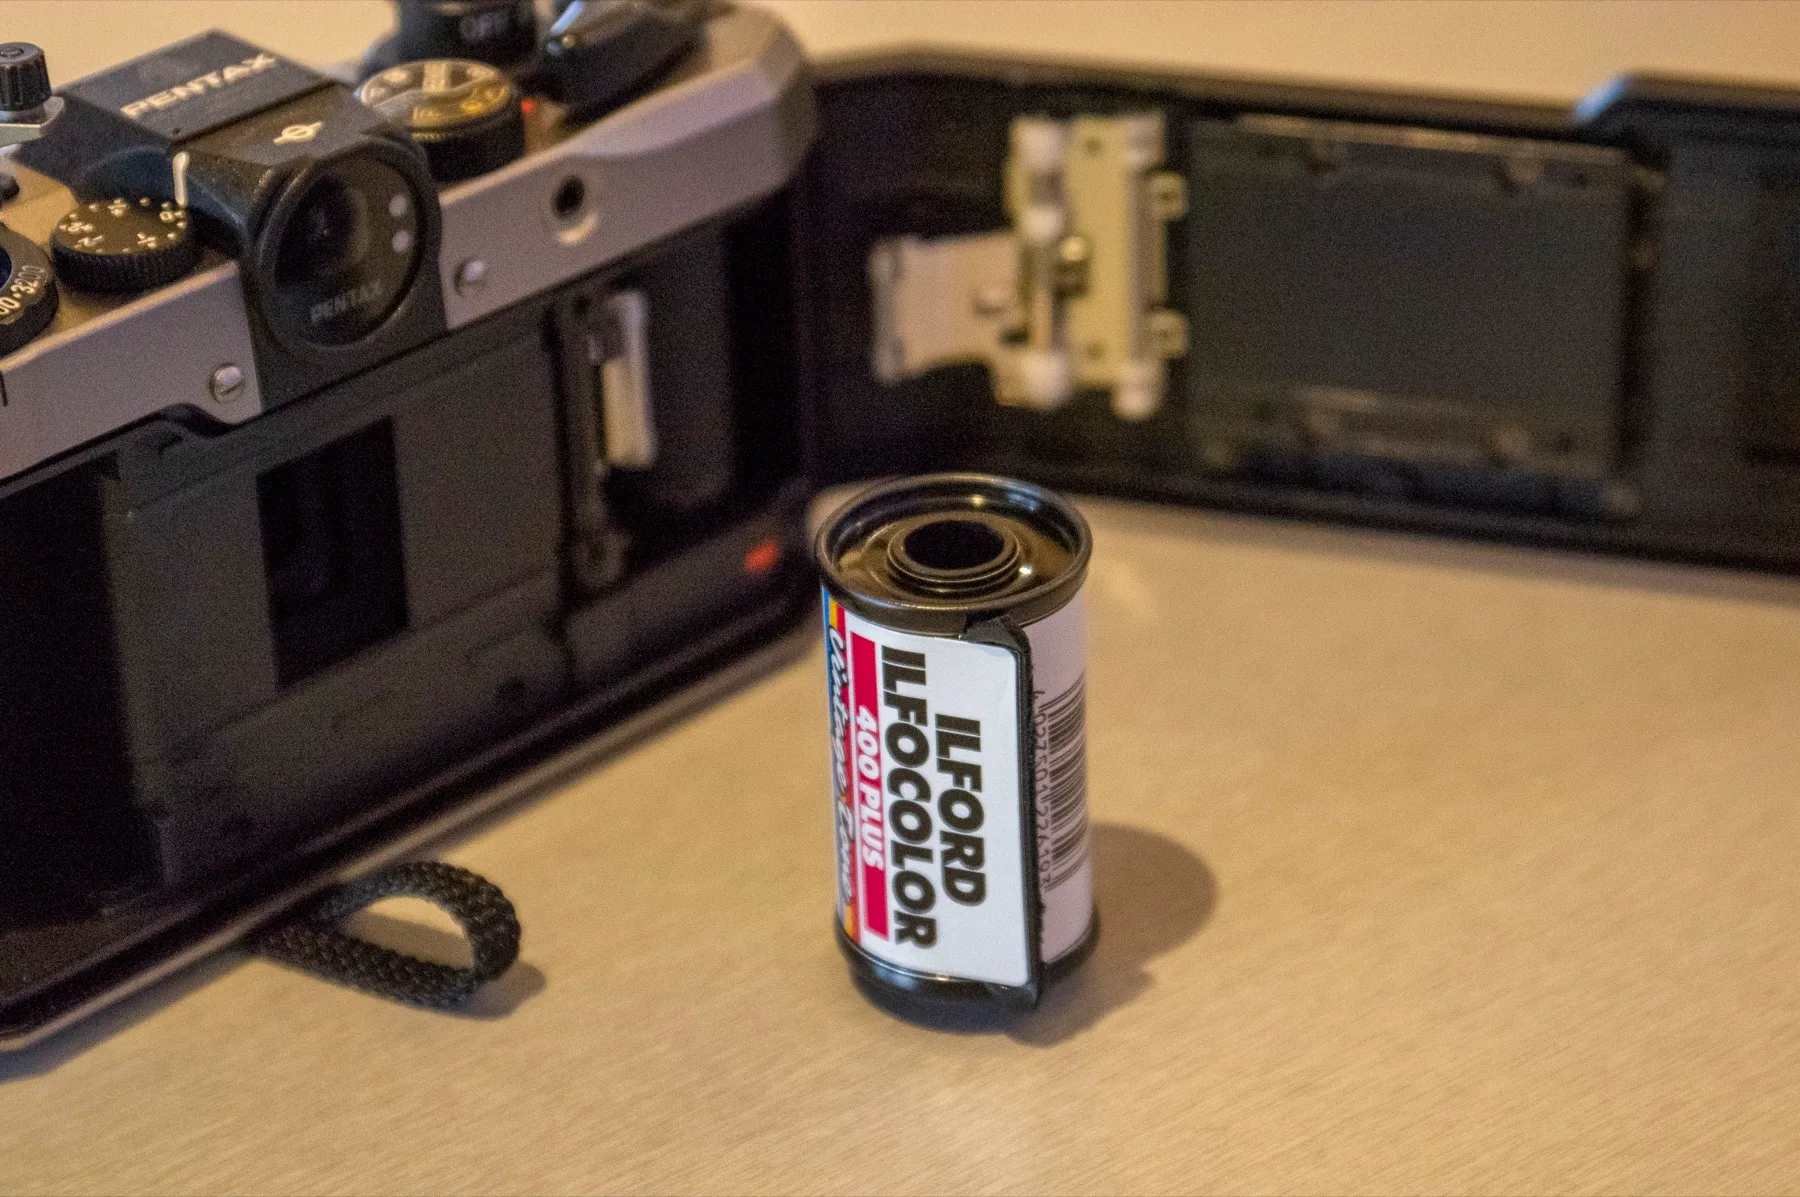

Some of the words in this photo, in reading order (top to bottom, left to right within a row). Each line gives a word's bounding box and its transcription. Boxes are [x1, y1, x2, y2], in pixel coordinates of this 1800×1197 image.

[120, 53, 276, 118] PENTAX
[829, 624, 849, 793] Vintage
[856, 704, 879, 780] 400
[859, 782, 885, 870] PLUS
[881, 645, 939, 950] ILFOCOLOR
[935, 713, 987, 907] ILFORD
[837, 800, 855, 902] Tone
